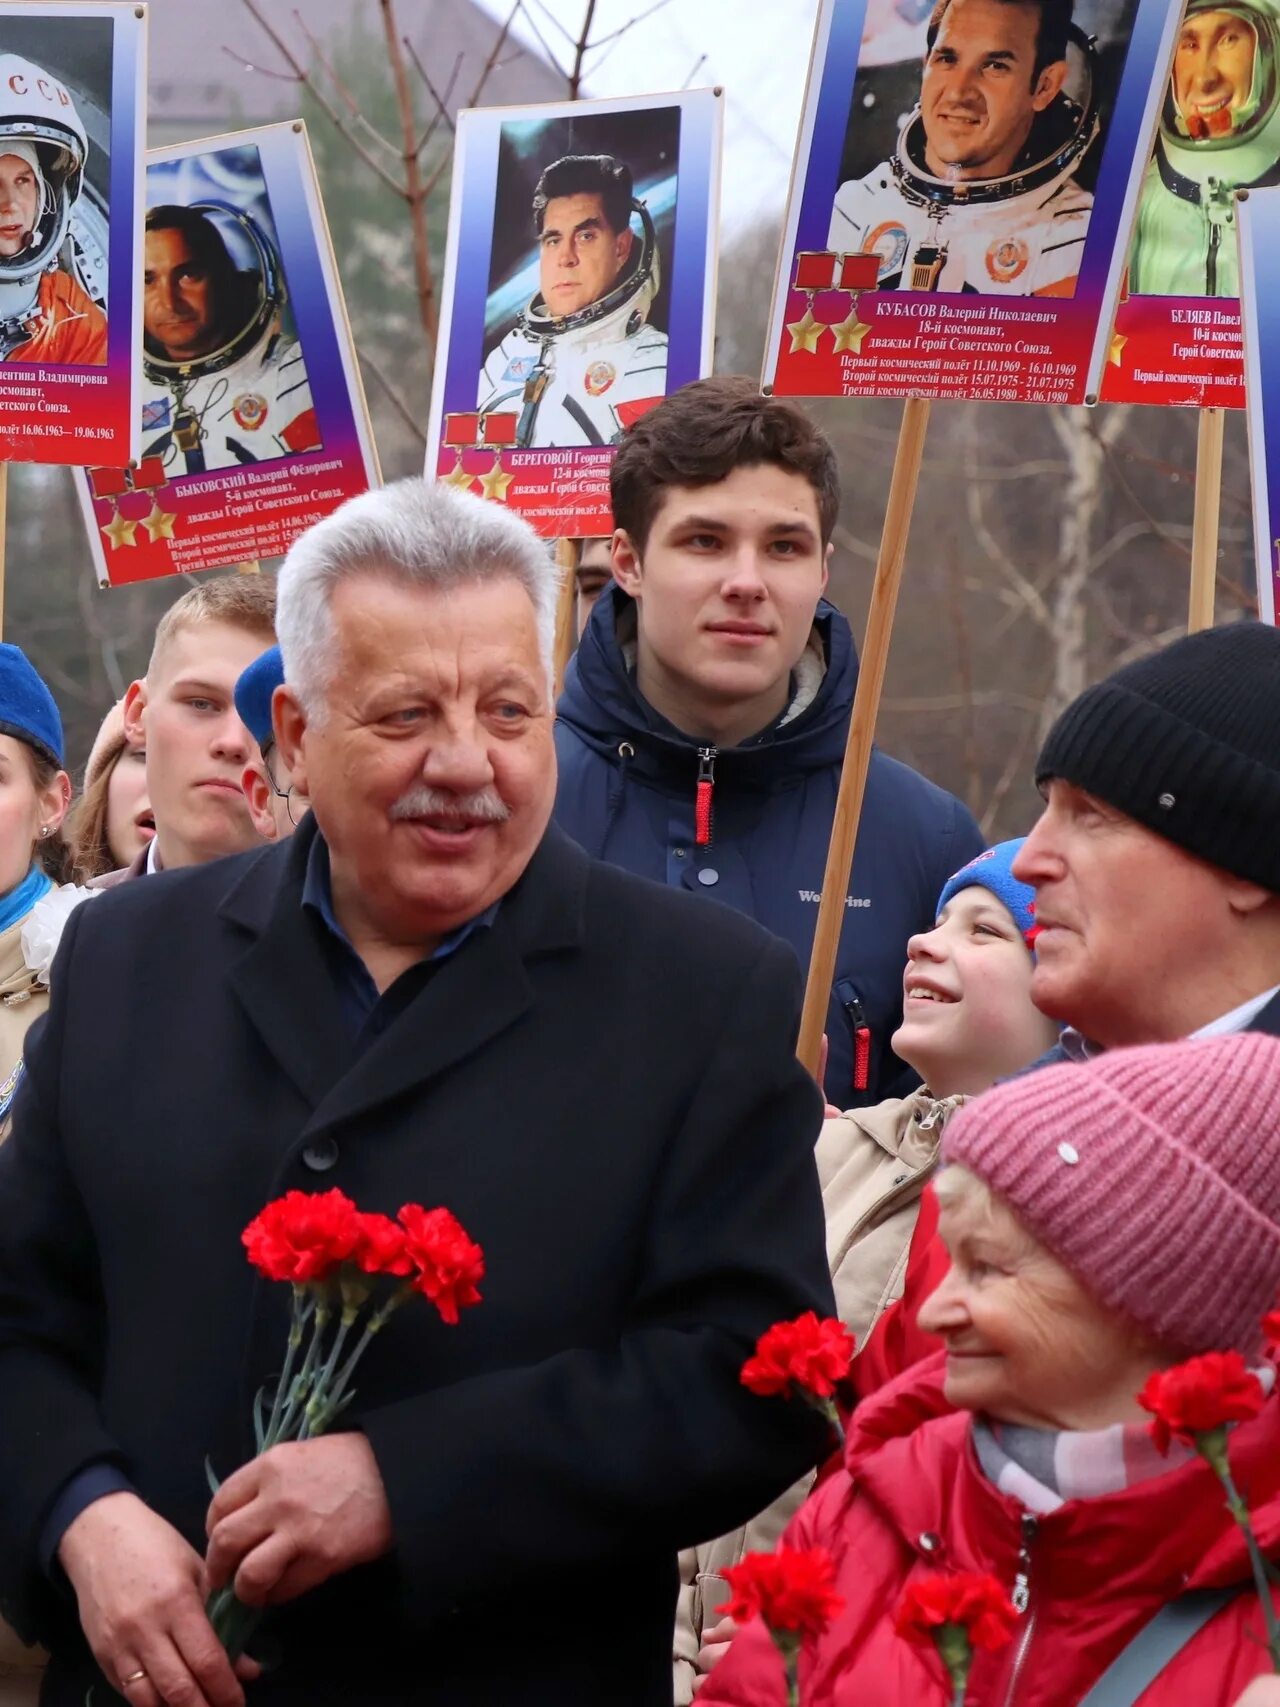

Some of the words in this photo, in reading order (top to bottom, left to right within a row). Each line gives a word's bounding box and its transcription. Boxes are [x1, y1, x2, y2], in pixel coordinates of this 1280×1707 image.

[876, 303, 936, 317] КУБАСОВ
[939, 304, 986, 322] Валерий
[989, 307, 1057, 323] Николаевич
[1171, 309, 1211, 323] БЕЛЯЕВ
[1213, 311, 1241, 326] Павел
[919, 320, 941, 334] 18-й
[944, 324, 1005, 338] космонавт,
[1193, 327, 1210, 341] 10-й
[868, 338, 911, 350] дважды
[914, 336, 947, 353] Герой
[950, 337, 1012, 353] Советского
[1015, 340, 1053, 355] Союза.
[1173, 343, 1199, 360] Герой
[840, 355, 878, 370] Первый
[879, 358, 941, 370] космический
[943, 360, 971, 371] полёт
[973, 359, 1020, 372] 11.10.1969
[1028, 362, 1077, 375] 16.10.1969
[39, 369, 108, 387] Владимировна
[843, 369, 876, 384] Второй
[878, 372, 939, 384] космический
[941, 374, 968, 386] полёт
[971, 373, 1019, 386] 15.07.1975
[1026, 376, 1075, 390] 21.07.1975
[1134, 368, 1164, 384] Первый
[1165, 371, 1213, 385] космический
[1214, 374, 1237, 386] полёт
[842, 384, 875, 397] Третий
[877, 386, 938, 398] космический
[940, 387, 968, 398] полёт
[969, 387, 1017, 400] 26.05.1980
[1024, 390, 1069, 403] 3.06.1980
[38, 400, 71, 413] Союза.
[74, 426, 115, 440] 19.06.1963
[511, 450, 573, 466] БЕРЕГОВОЙ
[575, 450, 612, 467] Георгий
[175, 472, 247, 498] БЫКОВСКИЙ
[247, 467, 289, 483] Валерий
[290, 459, 343, 476] Фёдорович
[553, 467, 572, 479] 12-й
[574, 466, 611, 477] космона
[225, 489, 242, 502] 5-й
[512, 484, 549, 495] дважды
[551, 481, 578, 496] Герой
[579, 481, 611, 493] Советс
[187, 509, 224, 525] дважды
[225, 502, 254, 518] Герой
[255, 495, 310, 511] Советского
[311, 488, 345, 501] Союза.
[523, 505, 574, 517] космический
[576, 506, 598, 515] полёт
[167, 534, 201, 550] Первый
[202, 524, 256, 541] космический
[256, 520, 280, 533] полёт
[171, 546, 202, 561] Второй
[202, 537, 257, 555] космический
[257, 533, 281, 545] полёт
[174, 558, 206, 572] Третий
[206, 548, 260, 567] космический
[261, 544, 285, 557] полёт
